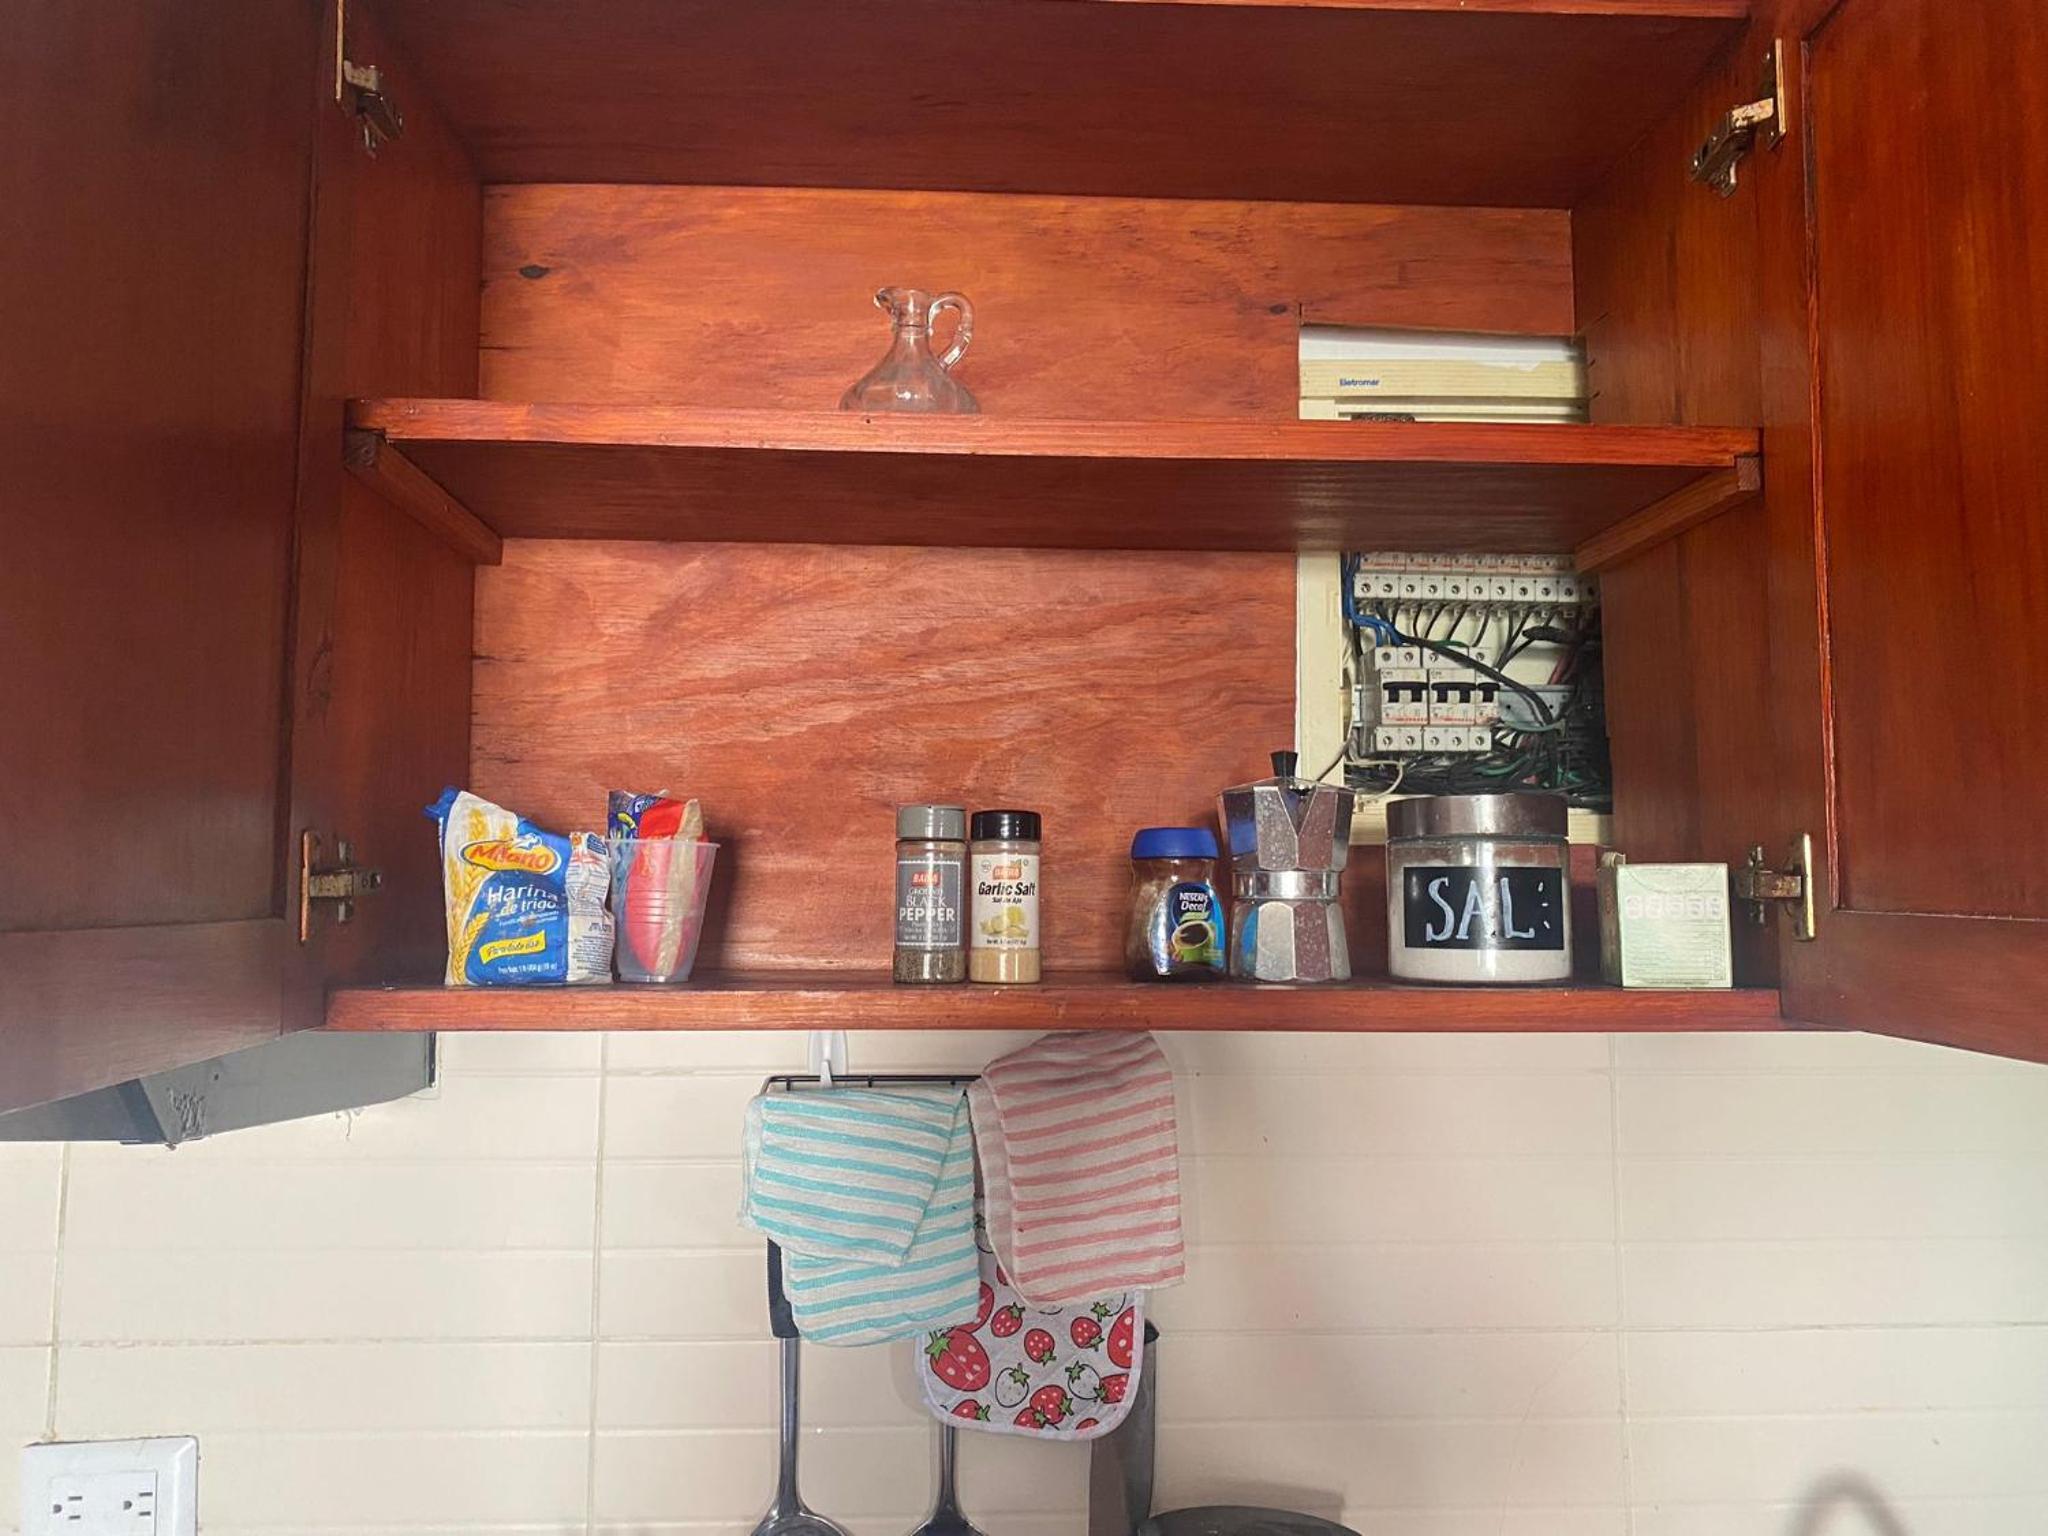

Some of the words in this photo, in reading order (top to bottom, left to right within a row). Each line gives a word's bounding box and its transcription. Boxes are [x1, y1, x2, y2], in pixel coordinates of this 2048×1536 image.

[1339, 378, 1380, 387] Eletromar
[487, 884, 559, 906] Harina
[978, 881, 1013, 896] Garlic
[1014, 881, 1036, 896] Salt
[500, 902, 517, 916] de
[522, 898, 557, 914] trigo
[905, 895, 948, 908] BLACK
[1426, 876, 1535, 942] SAL
[899, 907, 956, 921] PEPPER
